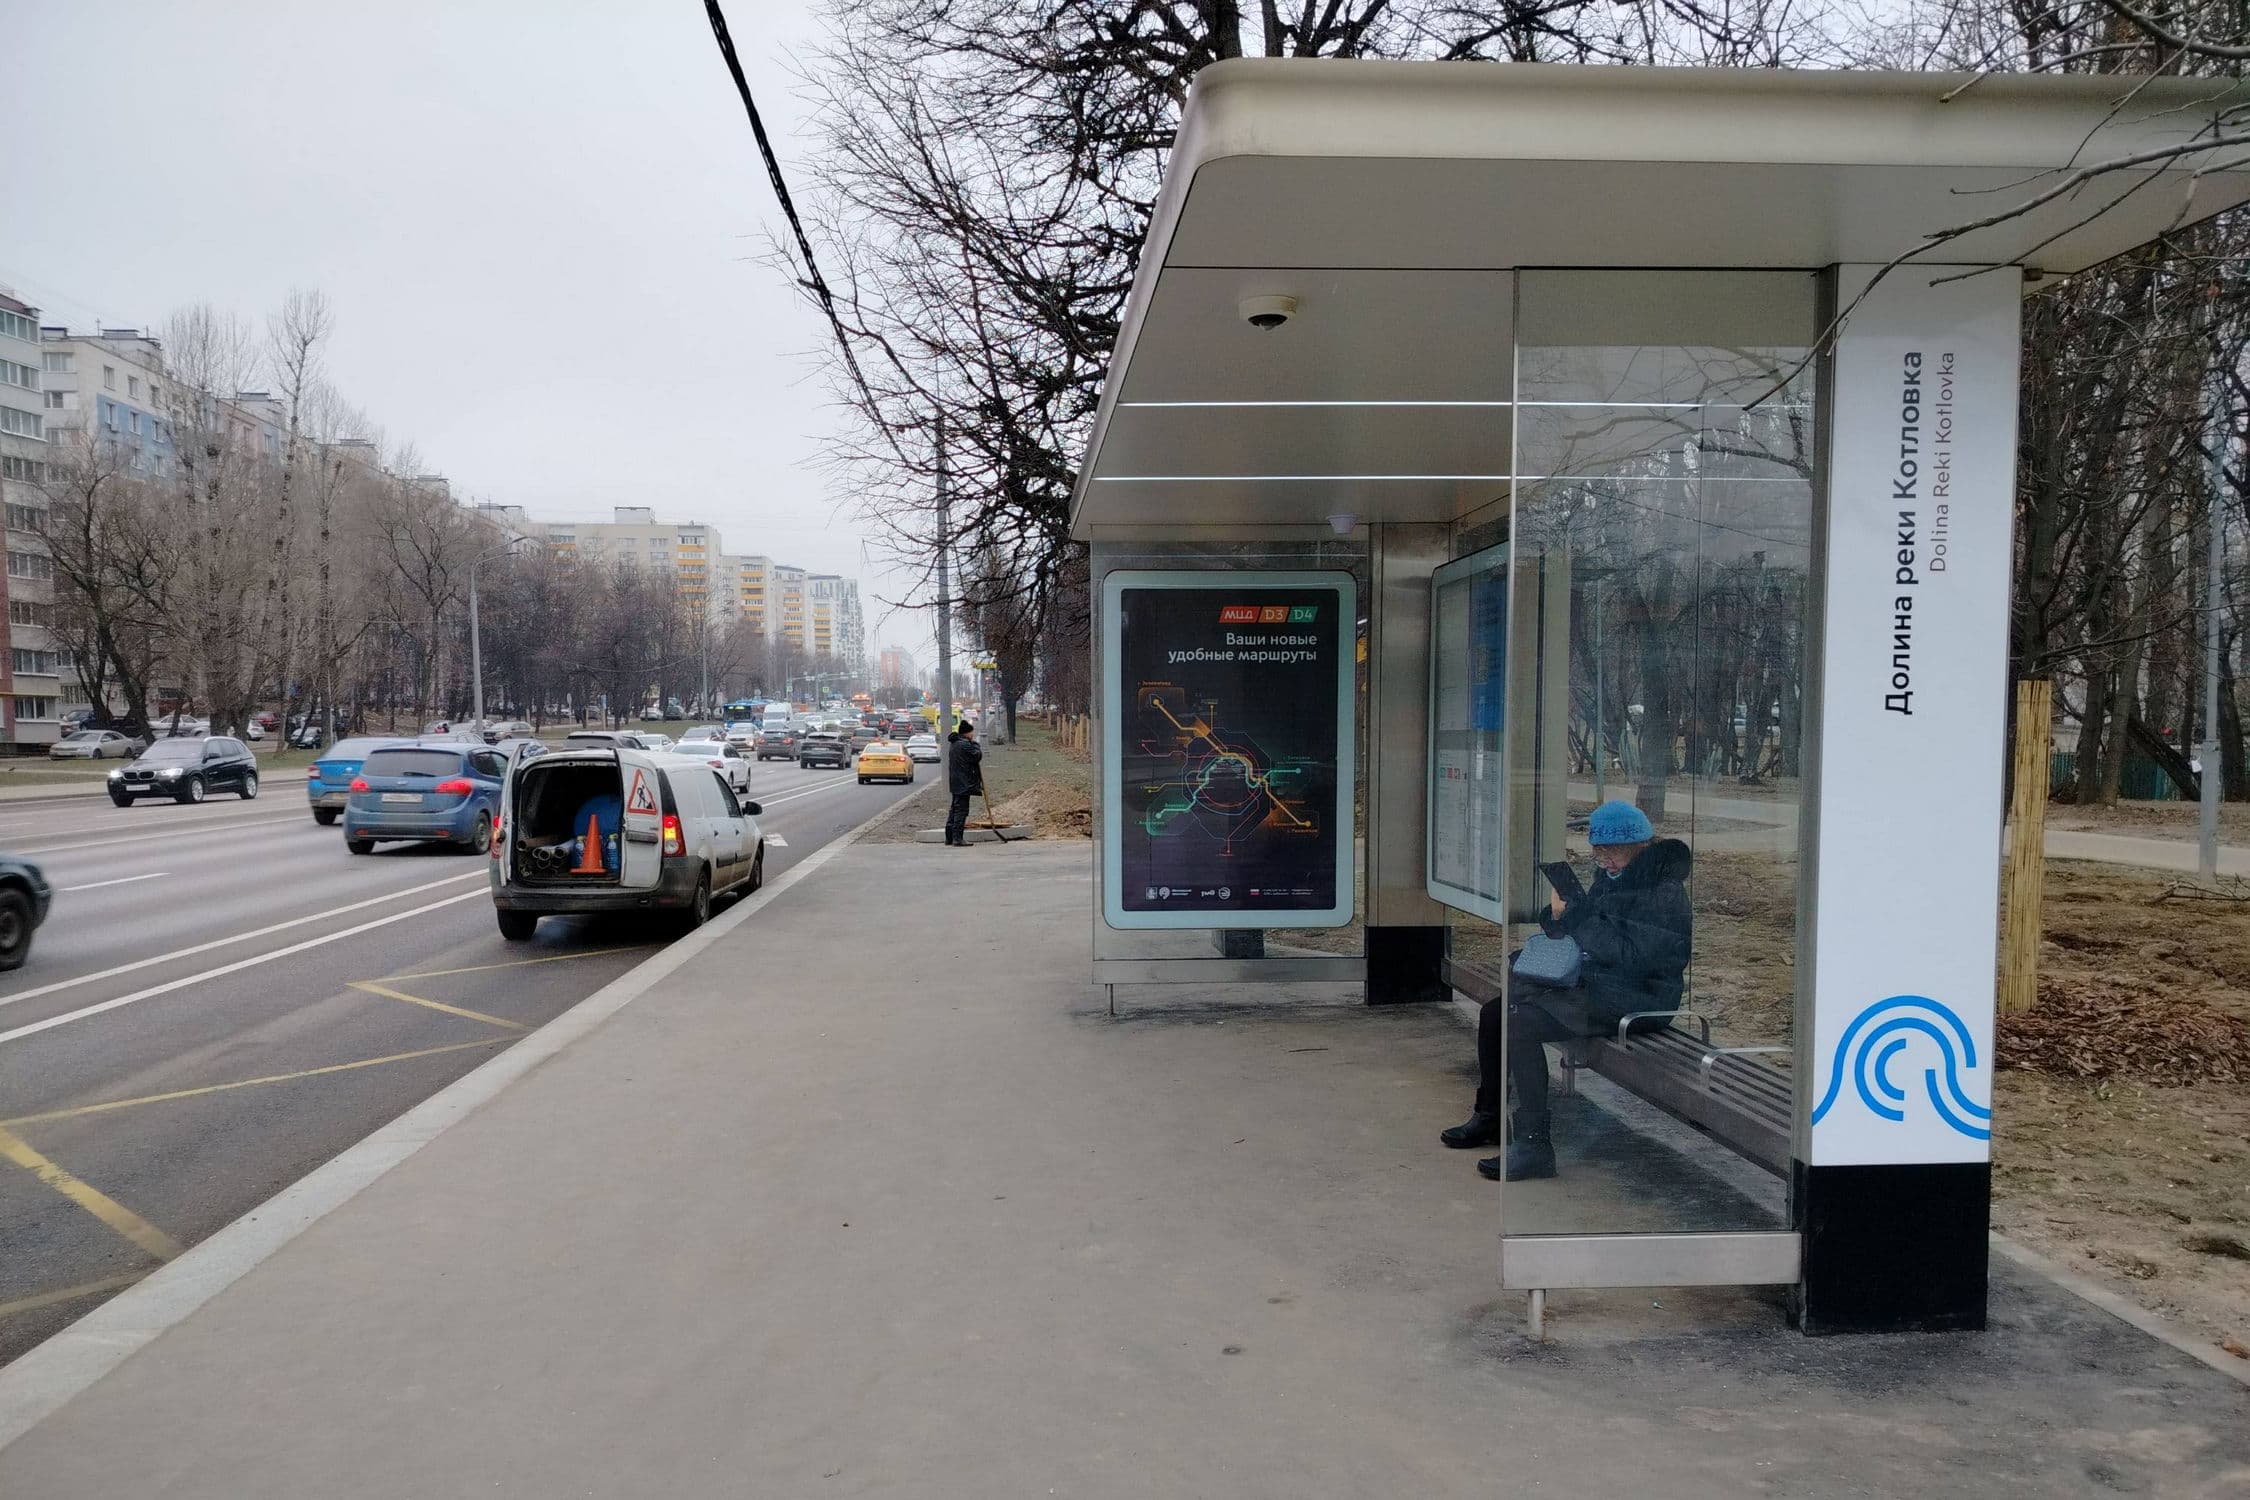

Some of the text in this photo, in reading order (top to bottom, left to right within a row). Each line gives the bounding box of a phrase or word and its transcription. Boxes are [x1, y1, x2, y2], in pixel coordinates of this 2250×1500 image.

[1930, 352, 1954, 572] Dolina Reki Kotlovka
[1885, 351, 1922, 716] Долина реки Котловка
[1224, 610, 1253, 620] МЦД
[1265, 609, 1313, 620] D3 D4
[1226, 632, 1318, 645] Ваши новые
[1168, 649, 1317, 664] удобные маршруты
